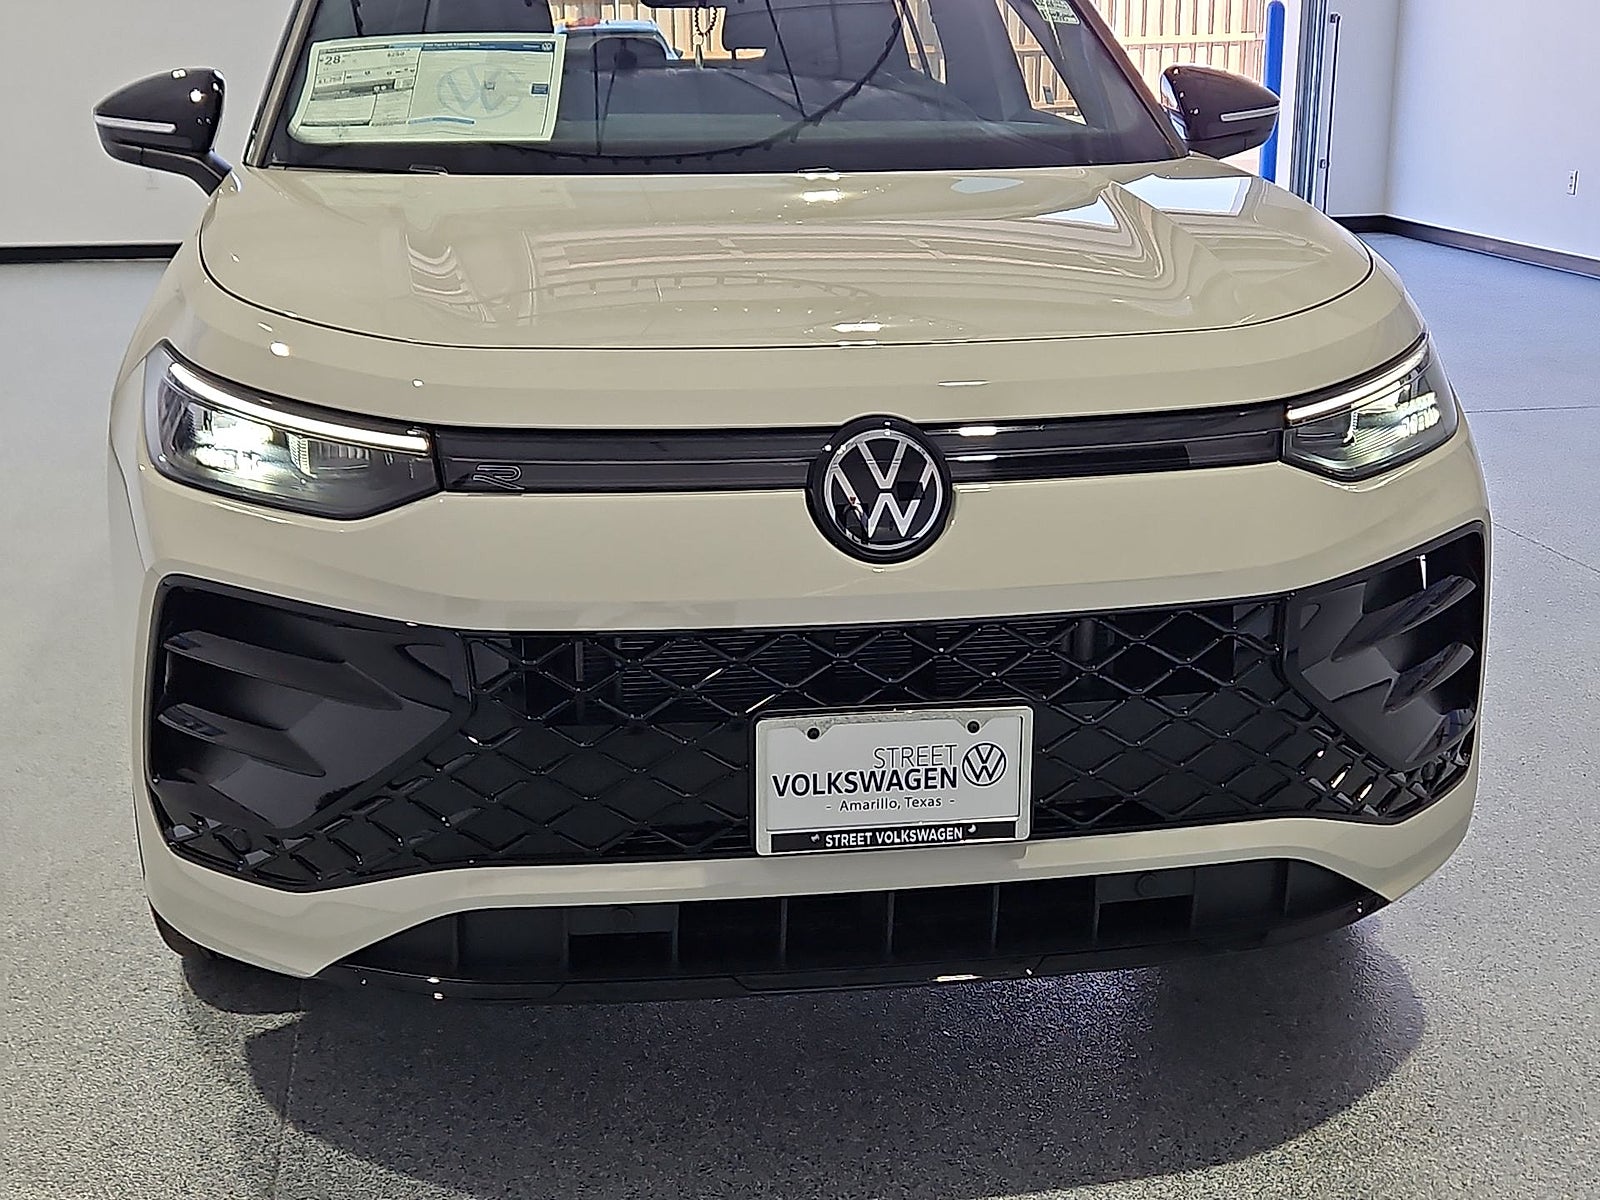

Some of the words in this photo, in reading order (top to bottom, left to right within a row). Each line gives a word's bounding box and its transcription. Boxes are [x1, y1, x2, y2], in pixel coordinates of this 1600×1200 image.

[324, 55, 341, 66] 28
[824, 429, 943, 550] VW
[873, 744, 958, 769] STREET
[962, 742, 1007, 787] VW
[772, 766, 958, 797] VOLKSWAGEN
[839, 797, 901, 812] Amarillo,
[904, 796, 942, 808] Texas
[825, 832, 873, 848] STREET
[876, 827, 963, 845] VOLKSWAGEN
